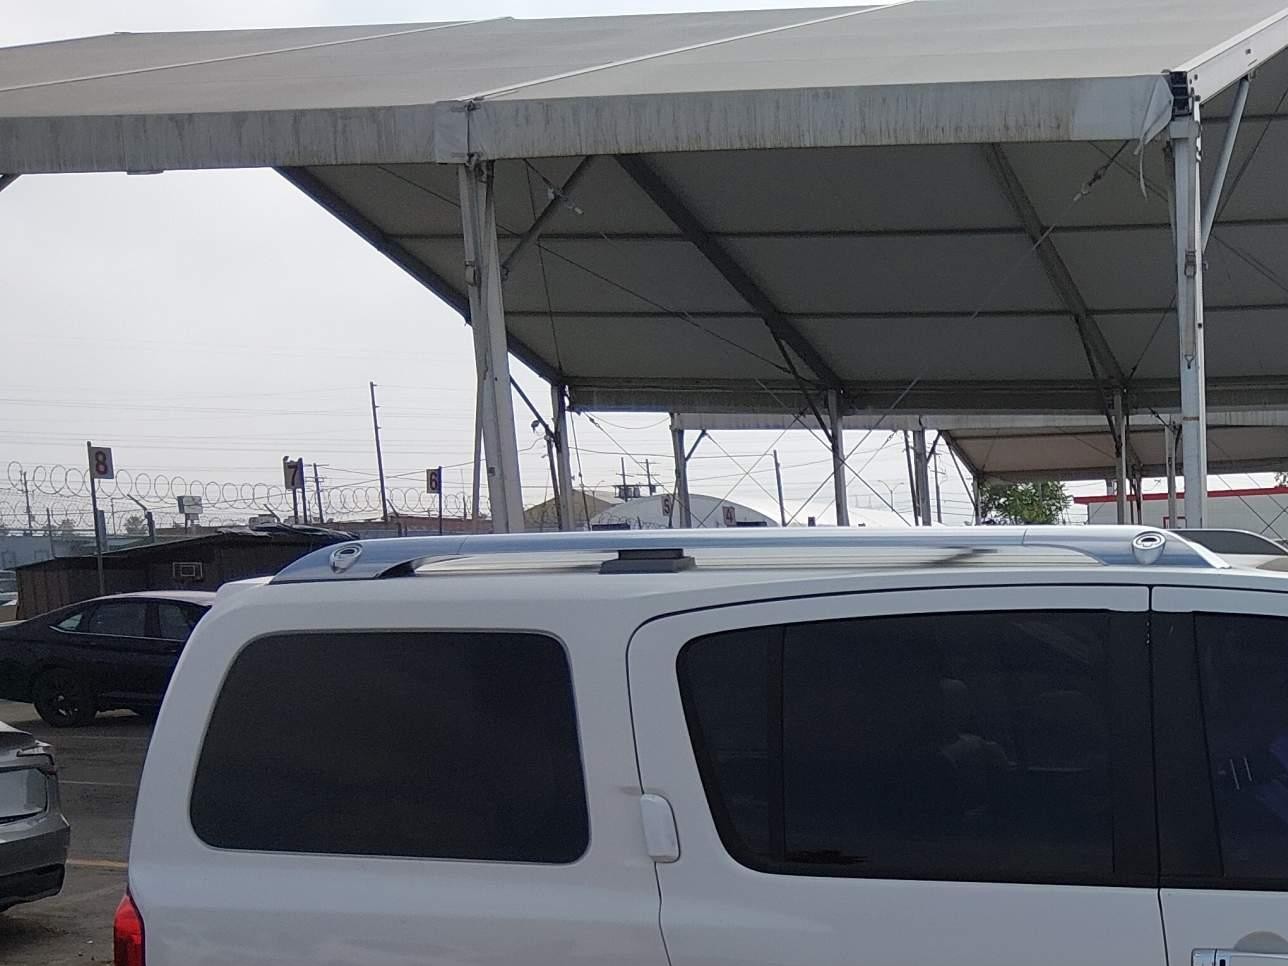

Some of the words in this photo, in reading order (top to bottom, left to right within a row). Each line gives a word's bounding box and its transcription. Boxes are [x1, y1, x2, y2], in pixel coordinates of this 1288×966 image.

[95, 451, 107, 475] 8
[287, 465, 299, 486] 7
[429, 473, 438, 491] 6
